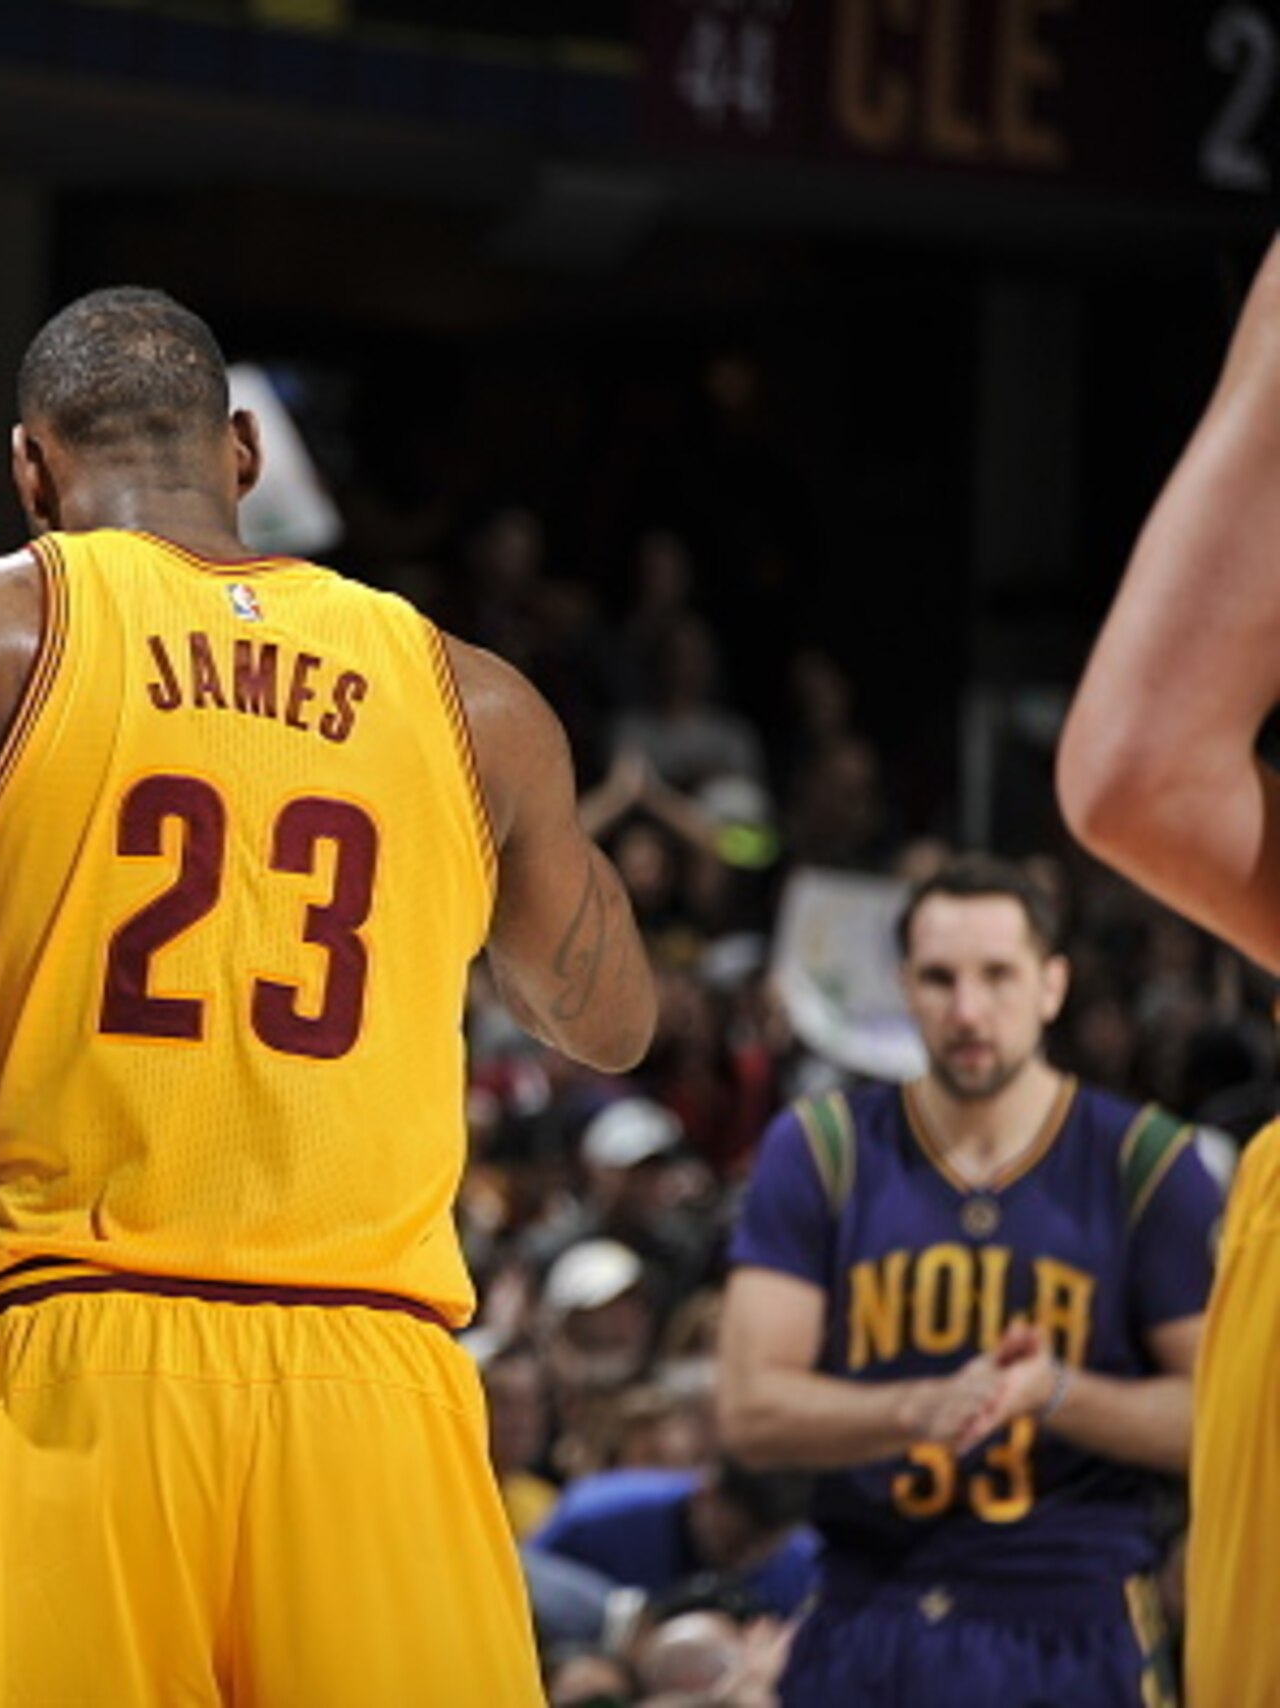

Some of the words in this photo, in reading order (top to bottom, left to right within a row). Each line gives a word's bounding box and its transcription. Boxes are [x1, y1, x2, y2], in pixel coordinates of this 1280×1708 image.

[828, 0, 1072, 170] CLE
[147, 631, 368, 743] JAMES
[98, 772, 379, 1060] 23
